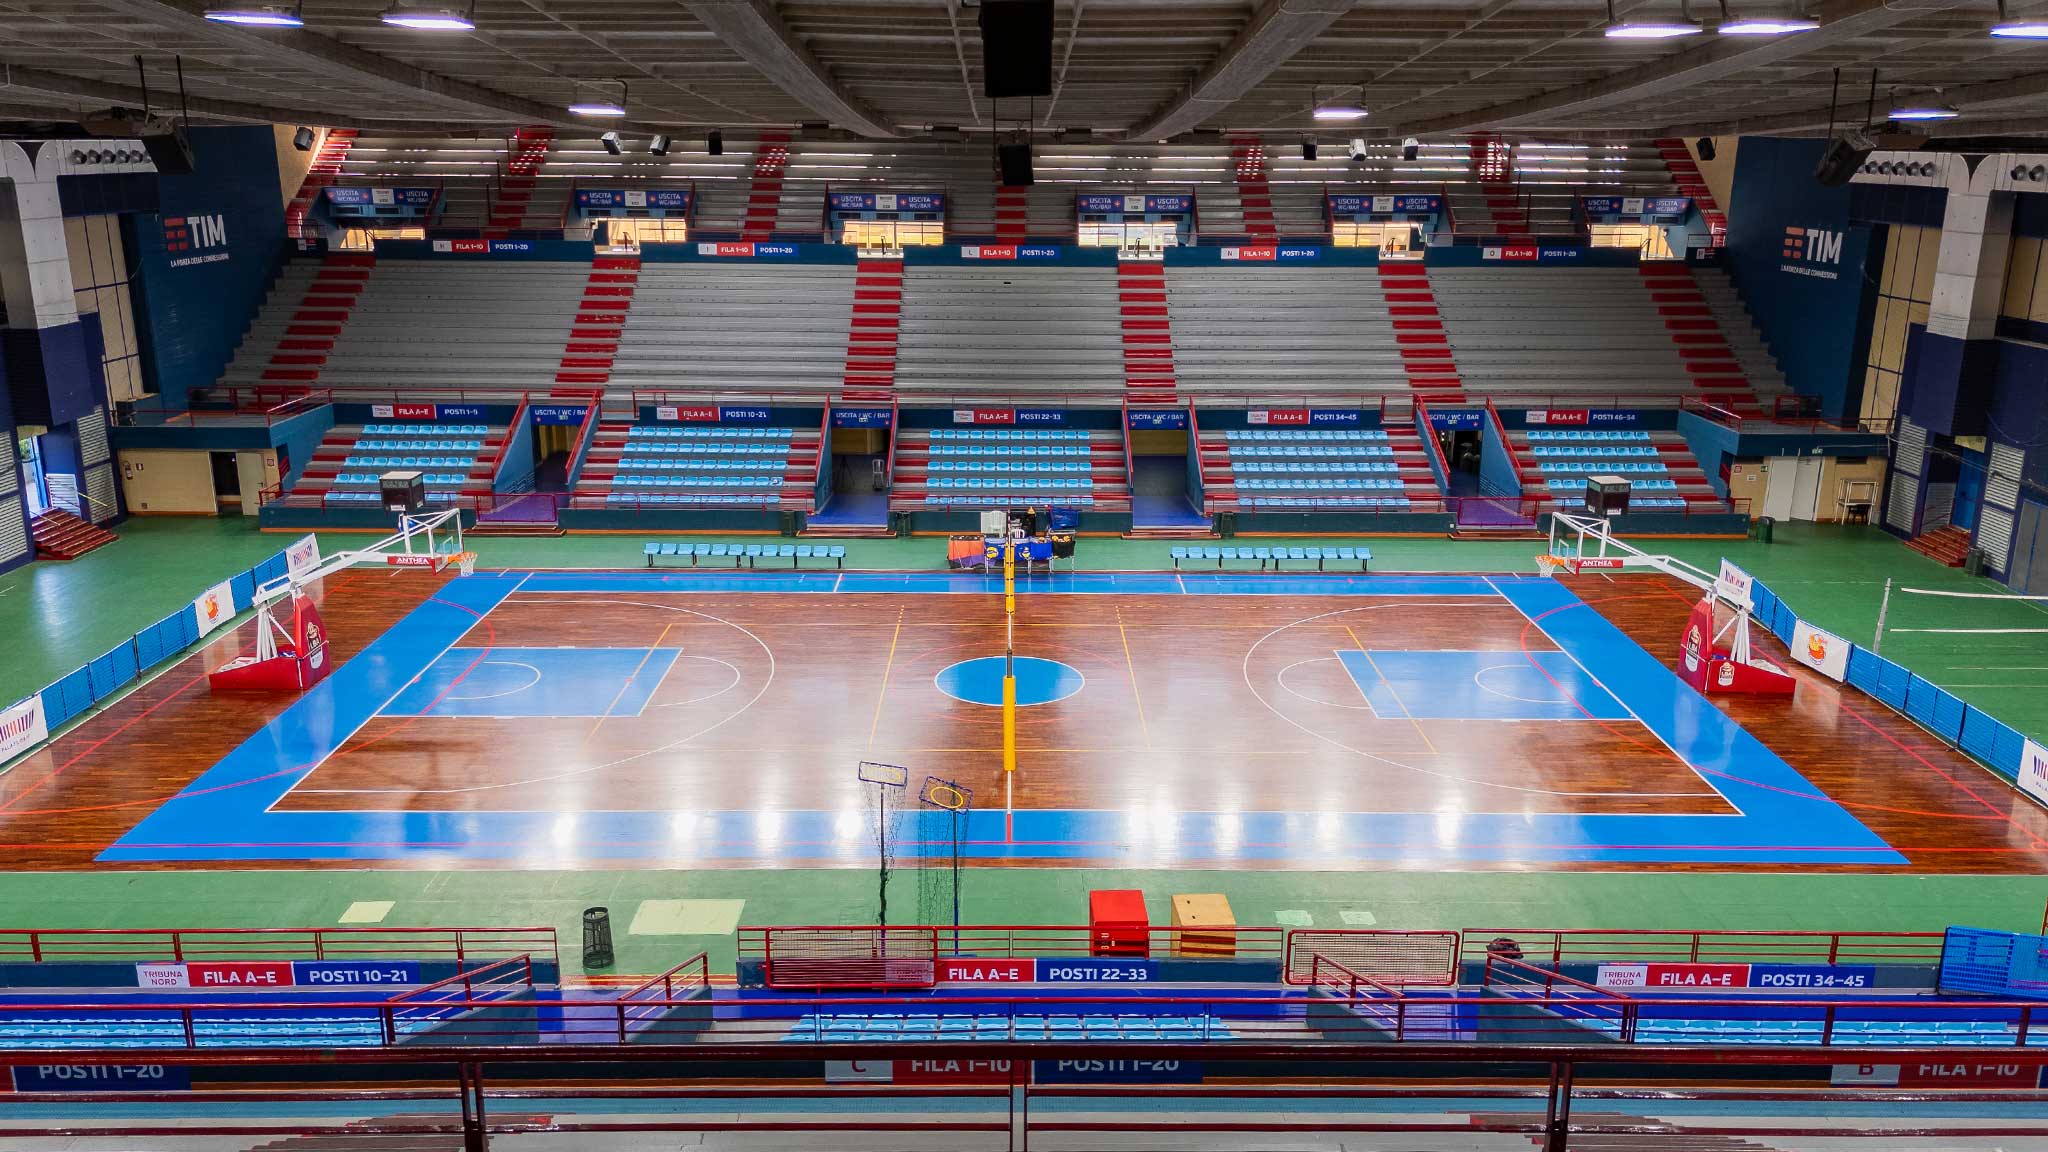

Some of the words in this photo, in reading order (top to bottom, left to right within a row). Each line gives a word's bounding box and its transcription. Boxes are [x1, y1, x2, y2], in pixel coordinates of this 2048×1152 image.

[187, 214, 227, 249] TIM
[1806, 228, 1843, 265] TIM
[396, 557, 430, 565] ANTHEA
[203, 971, 241, 984] FILA
[309, 970, 360, 983] POSTI
[949, 968, 984, 980] FILA
[1049, 968, 1098, 980] POSTI
[1660, 973, 1696, 985] FILA
[1761, 974, 1811, 986] POSTI
[151, 978, 177, 986] NORD
[1608, 978, 1634, 986] NORD
[38, 1065, 109, 1079] POSTI
[851, 1060, 867, 1073] C
[911, 1060, 961, 1072] FILA
[1058, 1060, 1125, 1072] POSTI
[1919, 1064, 1967, 1076] FILA
